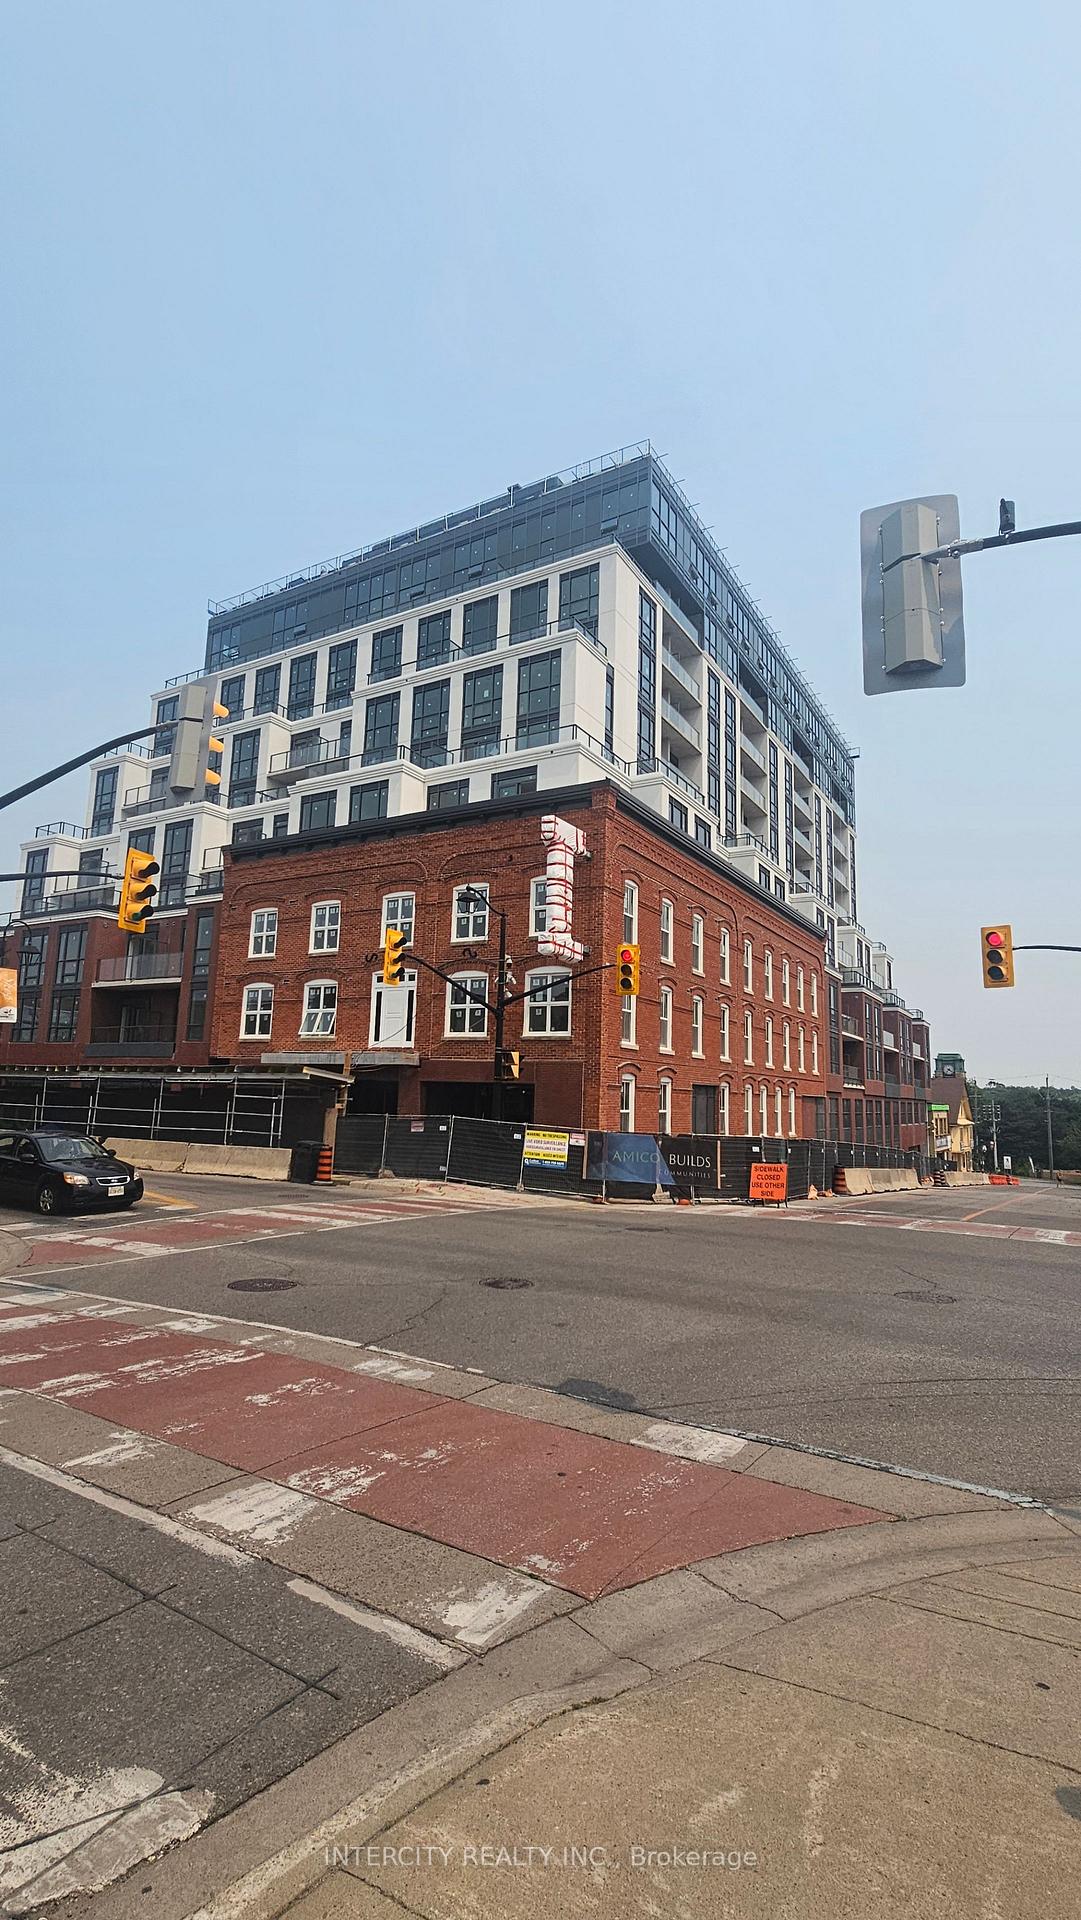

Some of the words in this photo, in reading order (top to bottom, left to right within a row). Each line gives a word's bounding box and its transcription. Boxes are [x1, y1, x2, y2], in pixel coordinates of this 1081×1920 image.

[612, 1151, 660, 1163] AMICO
[669, 1153, 711, 1168] BUILDS
[753, 1165, 785, 1173] SIDEWALK
